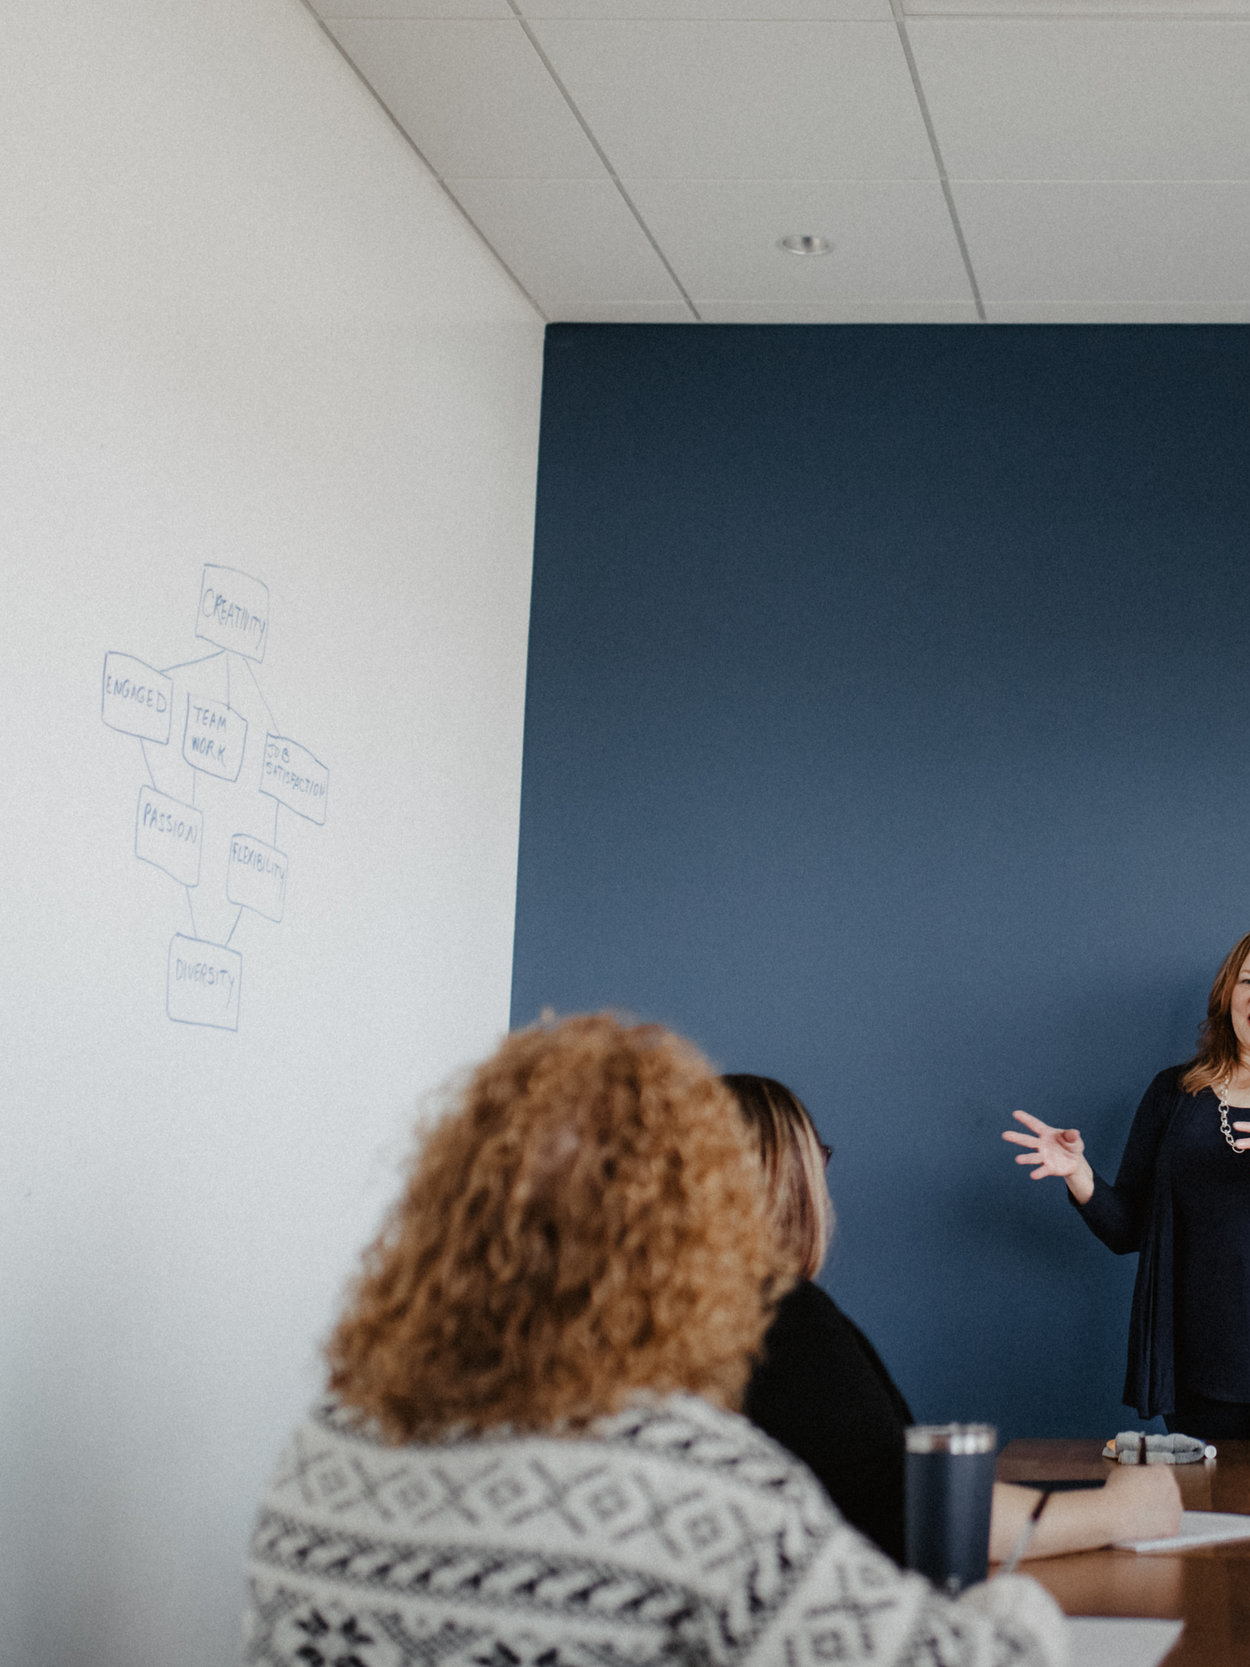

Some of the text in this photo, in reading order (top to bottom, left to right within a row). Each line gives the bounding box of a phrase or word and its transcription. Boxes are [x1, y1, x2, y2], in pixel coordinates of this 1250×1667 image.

[202, 588, 265, 650] CREATIVITY
[106, 676, 168, 713] ENGAGED
[193, 705, 227, 732] TEAM
[192, 737, 226, 767] WORK
[267, 744, 290, 764] JOB
[266, 761, 326, 798] SATISFACTION
[143, 802, 198, 843] PASSION
[232, 842, 286, 896] FLEXIBILITY
[175, 958, 235, 1009] DIVERSITY
